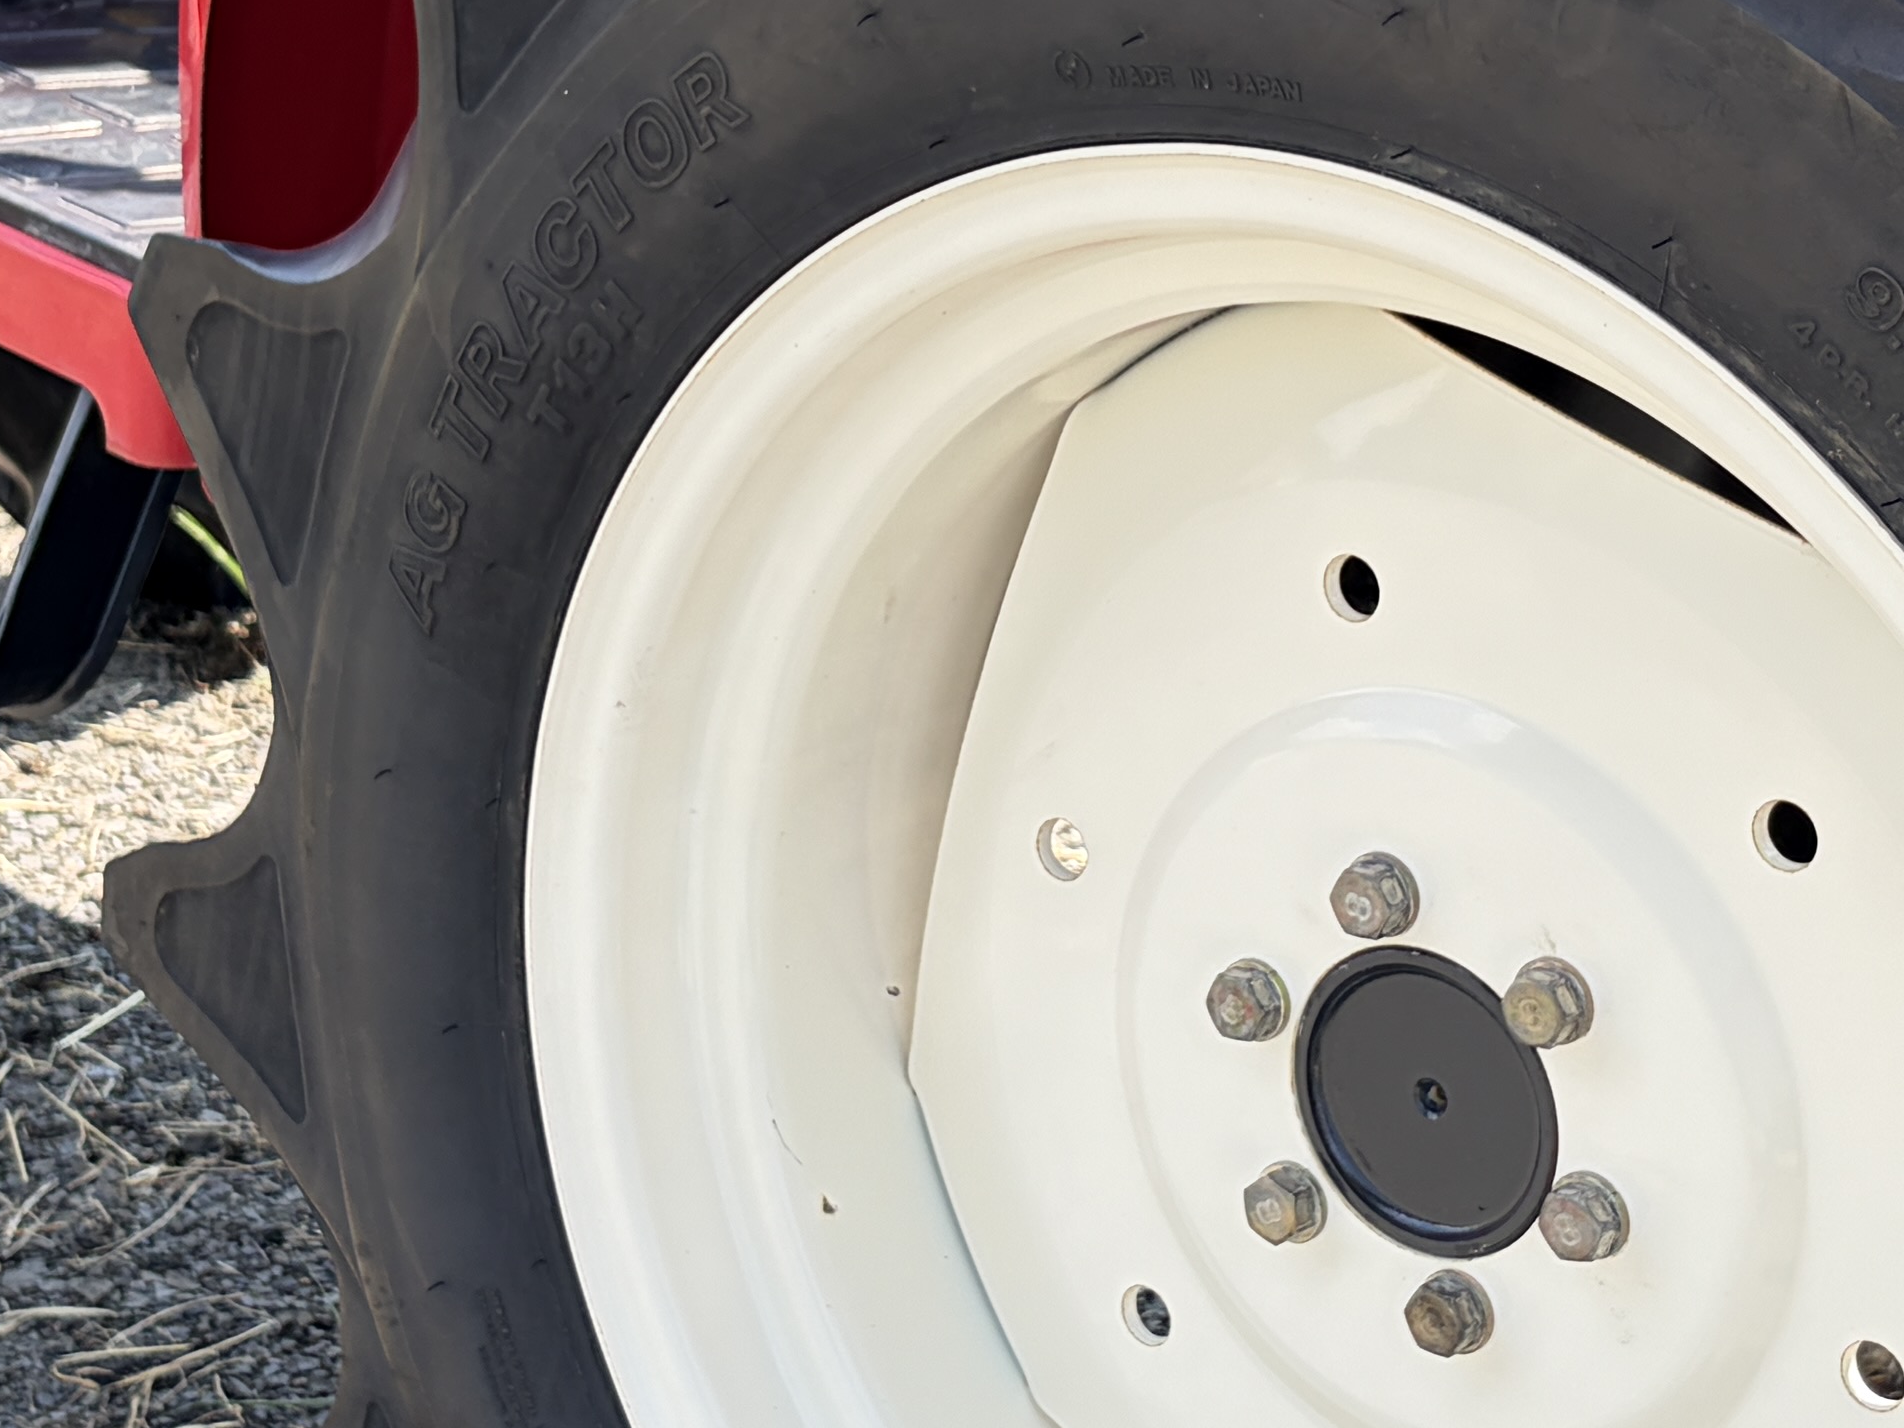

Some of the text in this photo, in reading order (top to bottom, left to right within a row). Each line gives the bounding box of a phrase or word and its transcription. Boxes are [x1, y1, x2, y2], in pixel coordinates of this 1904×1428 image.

[1106, 64, 1304, 104] MADE IN JAPAN
[385, 50, 753, 637] AG TRACTOR
[523, 279, 648, 437] T13H
